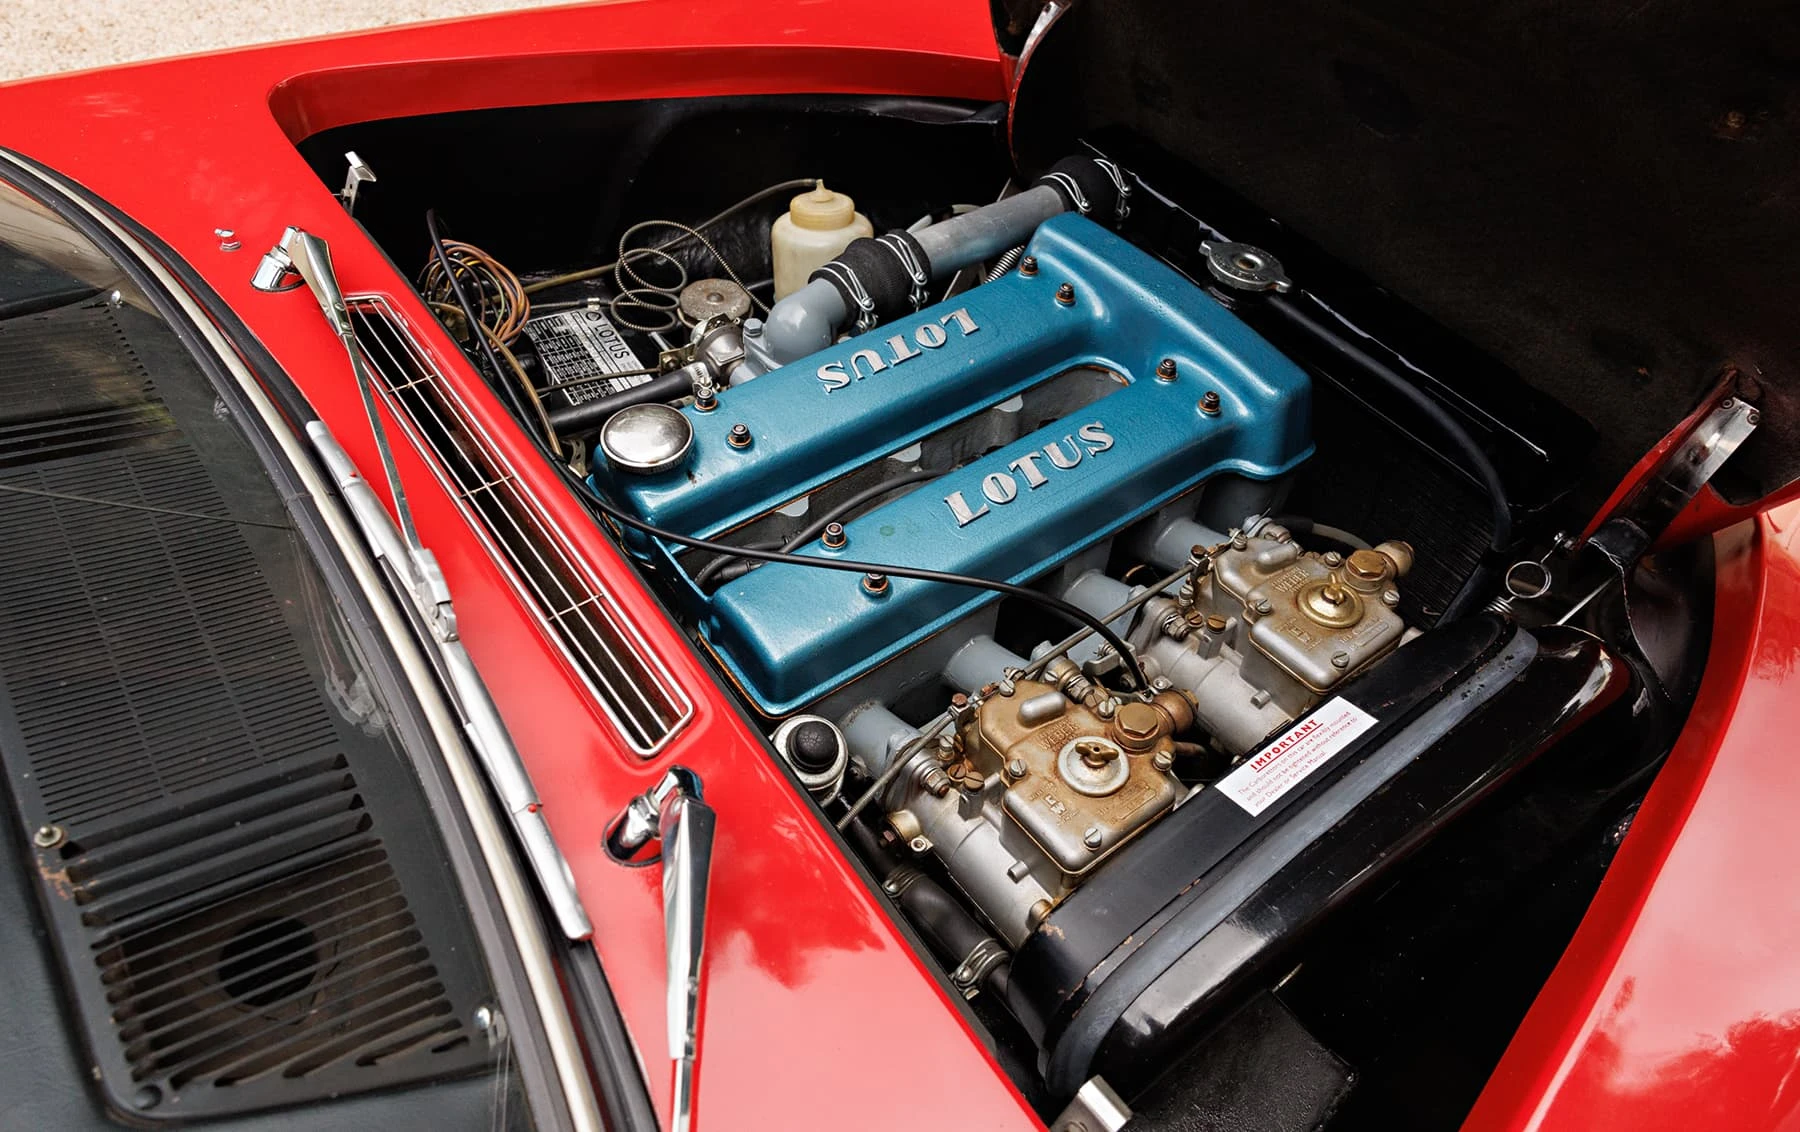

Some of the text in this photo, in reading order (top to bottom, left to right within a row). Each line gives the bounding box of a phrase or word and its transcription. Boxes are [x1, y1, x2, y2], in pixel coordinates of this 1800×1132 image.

[594, 324, 630, 360] LOTUS
[816, 307, 980, 394] LOTUS
[943, 421, 1115, 528] LOTUS
[1249, 719, 1318, 770] IMPORTANT
